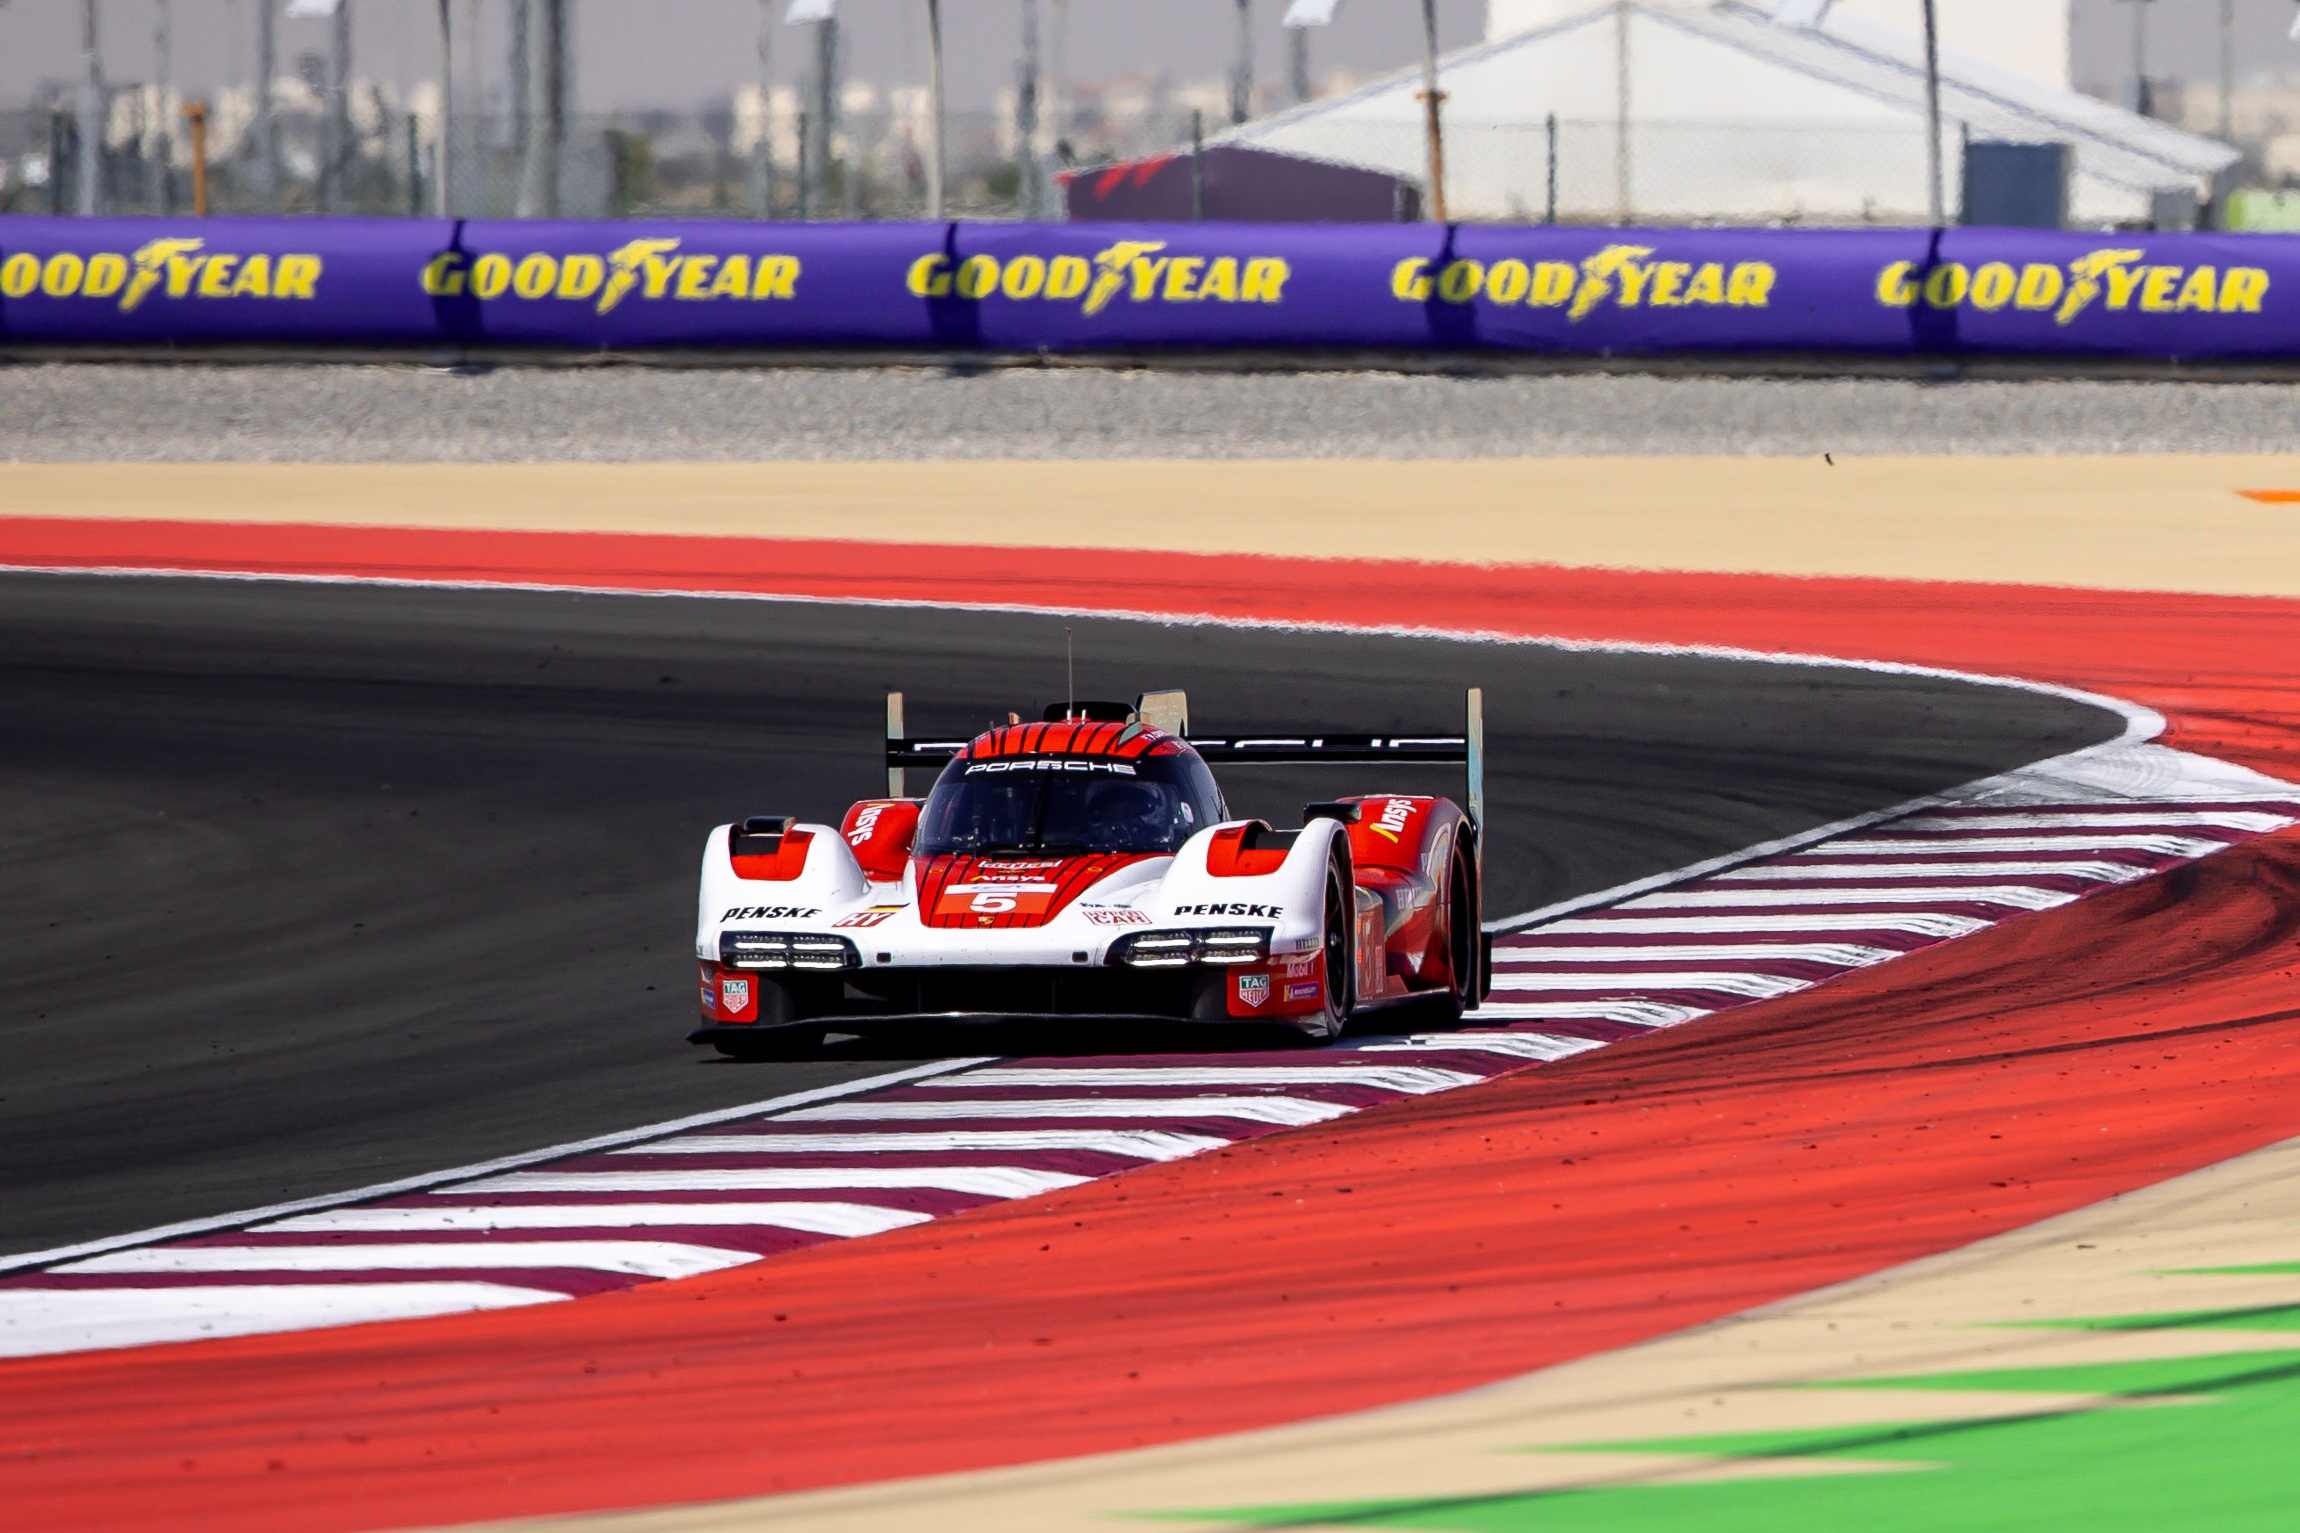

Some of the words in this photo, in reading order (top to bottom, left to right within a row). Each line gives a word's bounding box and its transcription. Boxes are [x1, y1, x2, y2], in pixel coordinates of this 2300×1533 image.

[422, 253, 800, 299] GOODYEAR
[907, 253, 1290, 302] GOODYEAR
[1392, 257, 1776, 306] GOODYEAR
[1877, 260, 2270, 312] GOODYEAR
[965, 760, 1137, 776] PORSCHE
[970, 892, 1017, 913] 5
[1173, 903, 1284, 920] PENSKE
[720, 906, 823, 923] PENSKE
[725, 982, 747, 994] TAG
[1242, 977, 1268, 989] TAG
